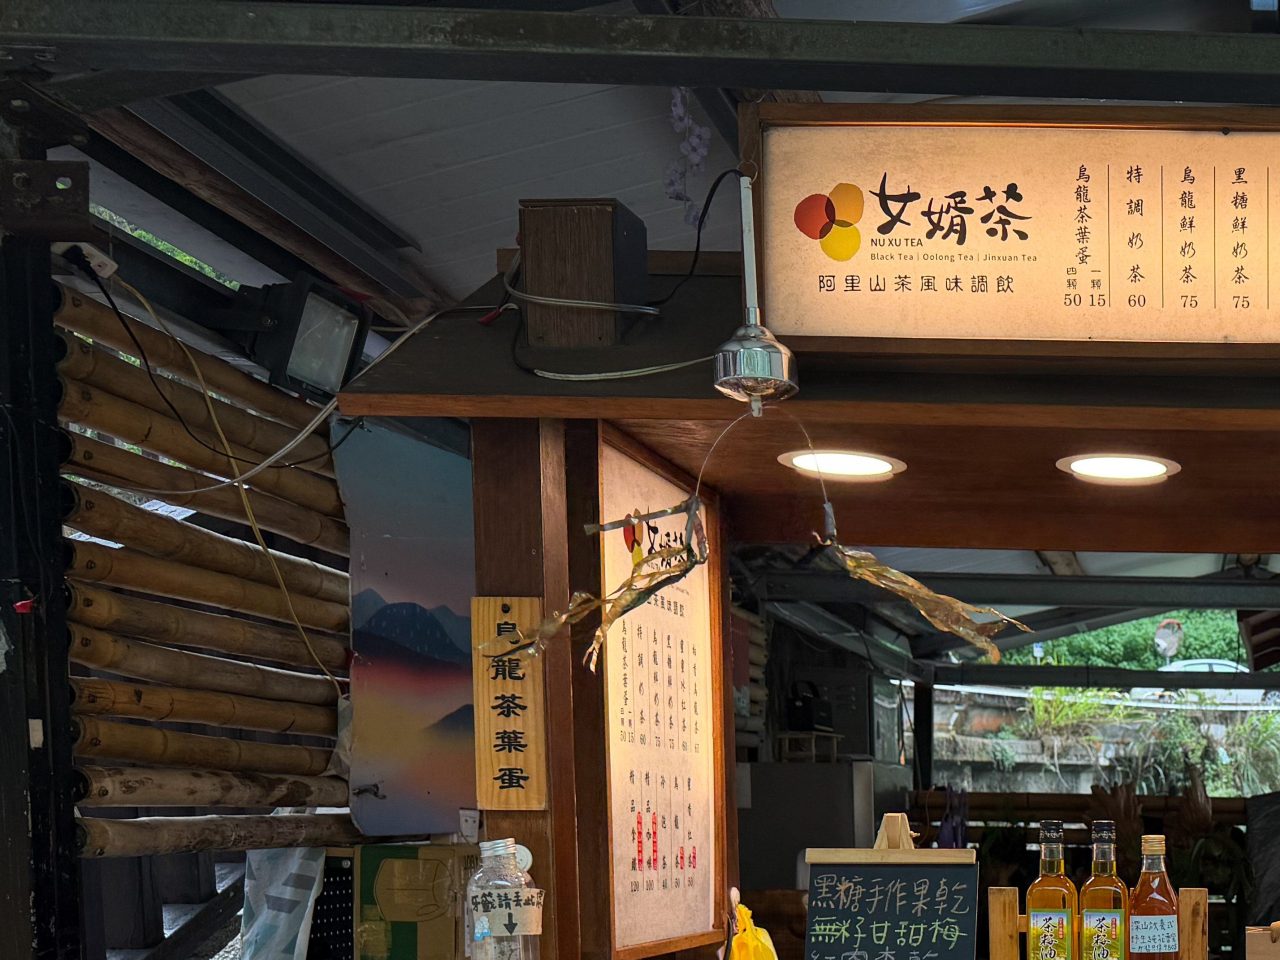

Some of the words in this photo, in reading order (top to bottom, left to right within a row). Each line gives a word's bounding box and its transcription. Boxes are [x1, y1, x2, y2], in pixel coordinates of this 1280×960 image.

[869, 172, 1032, 246] 女婿茶
[1126, 165, 1146, 284] 特調奶茶
[1179, 166, 1198, 284] 烏龍鮮奶茶
[1231, 168, 1250, 285] 黑糖鮮奶茶
[870, 238, 886, 248] NU
[888, 238, 902, 248] XU
[904, 238, 923, 248] TEA
[870, 252, 896, 262] Black
[898, 252, 914, 262] Tea
[922, 252, 956, 263] Oolong
[958, 252, 974, 262] Tea
[983, 252, 1019, 262] Jinxuan
[1022, 252, 1038, 262] Tea
[818, 274, 1014, 294] 阿里山茶風味調飲
[1063, 294, 1082, 308] 50
[1088, 294, 1106, 308] 15
[1127, 294, 1146, 308] 60
[1180, 295, 1198, 309] 75
[1232, 296, 1250, 310] 75
[810, 916, 968, 950] 無籽甘甜梅
